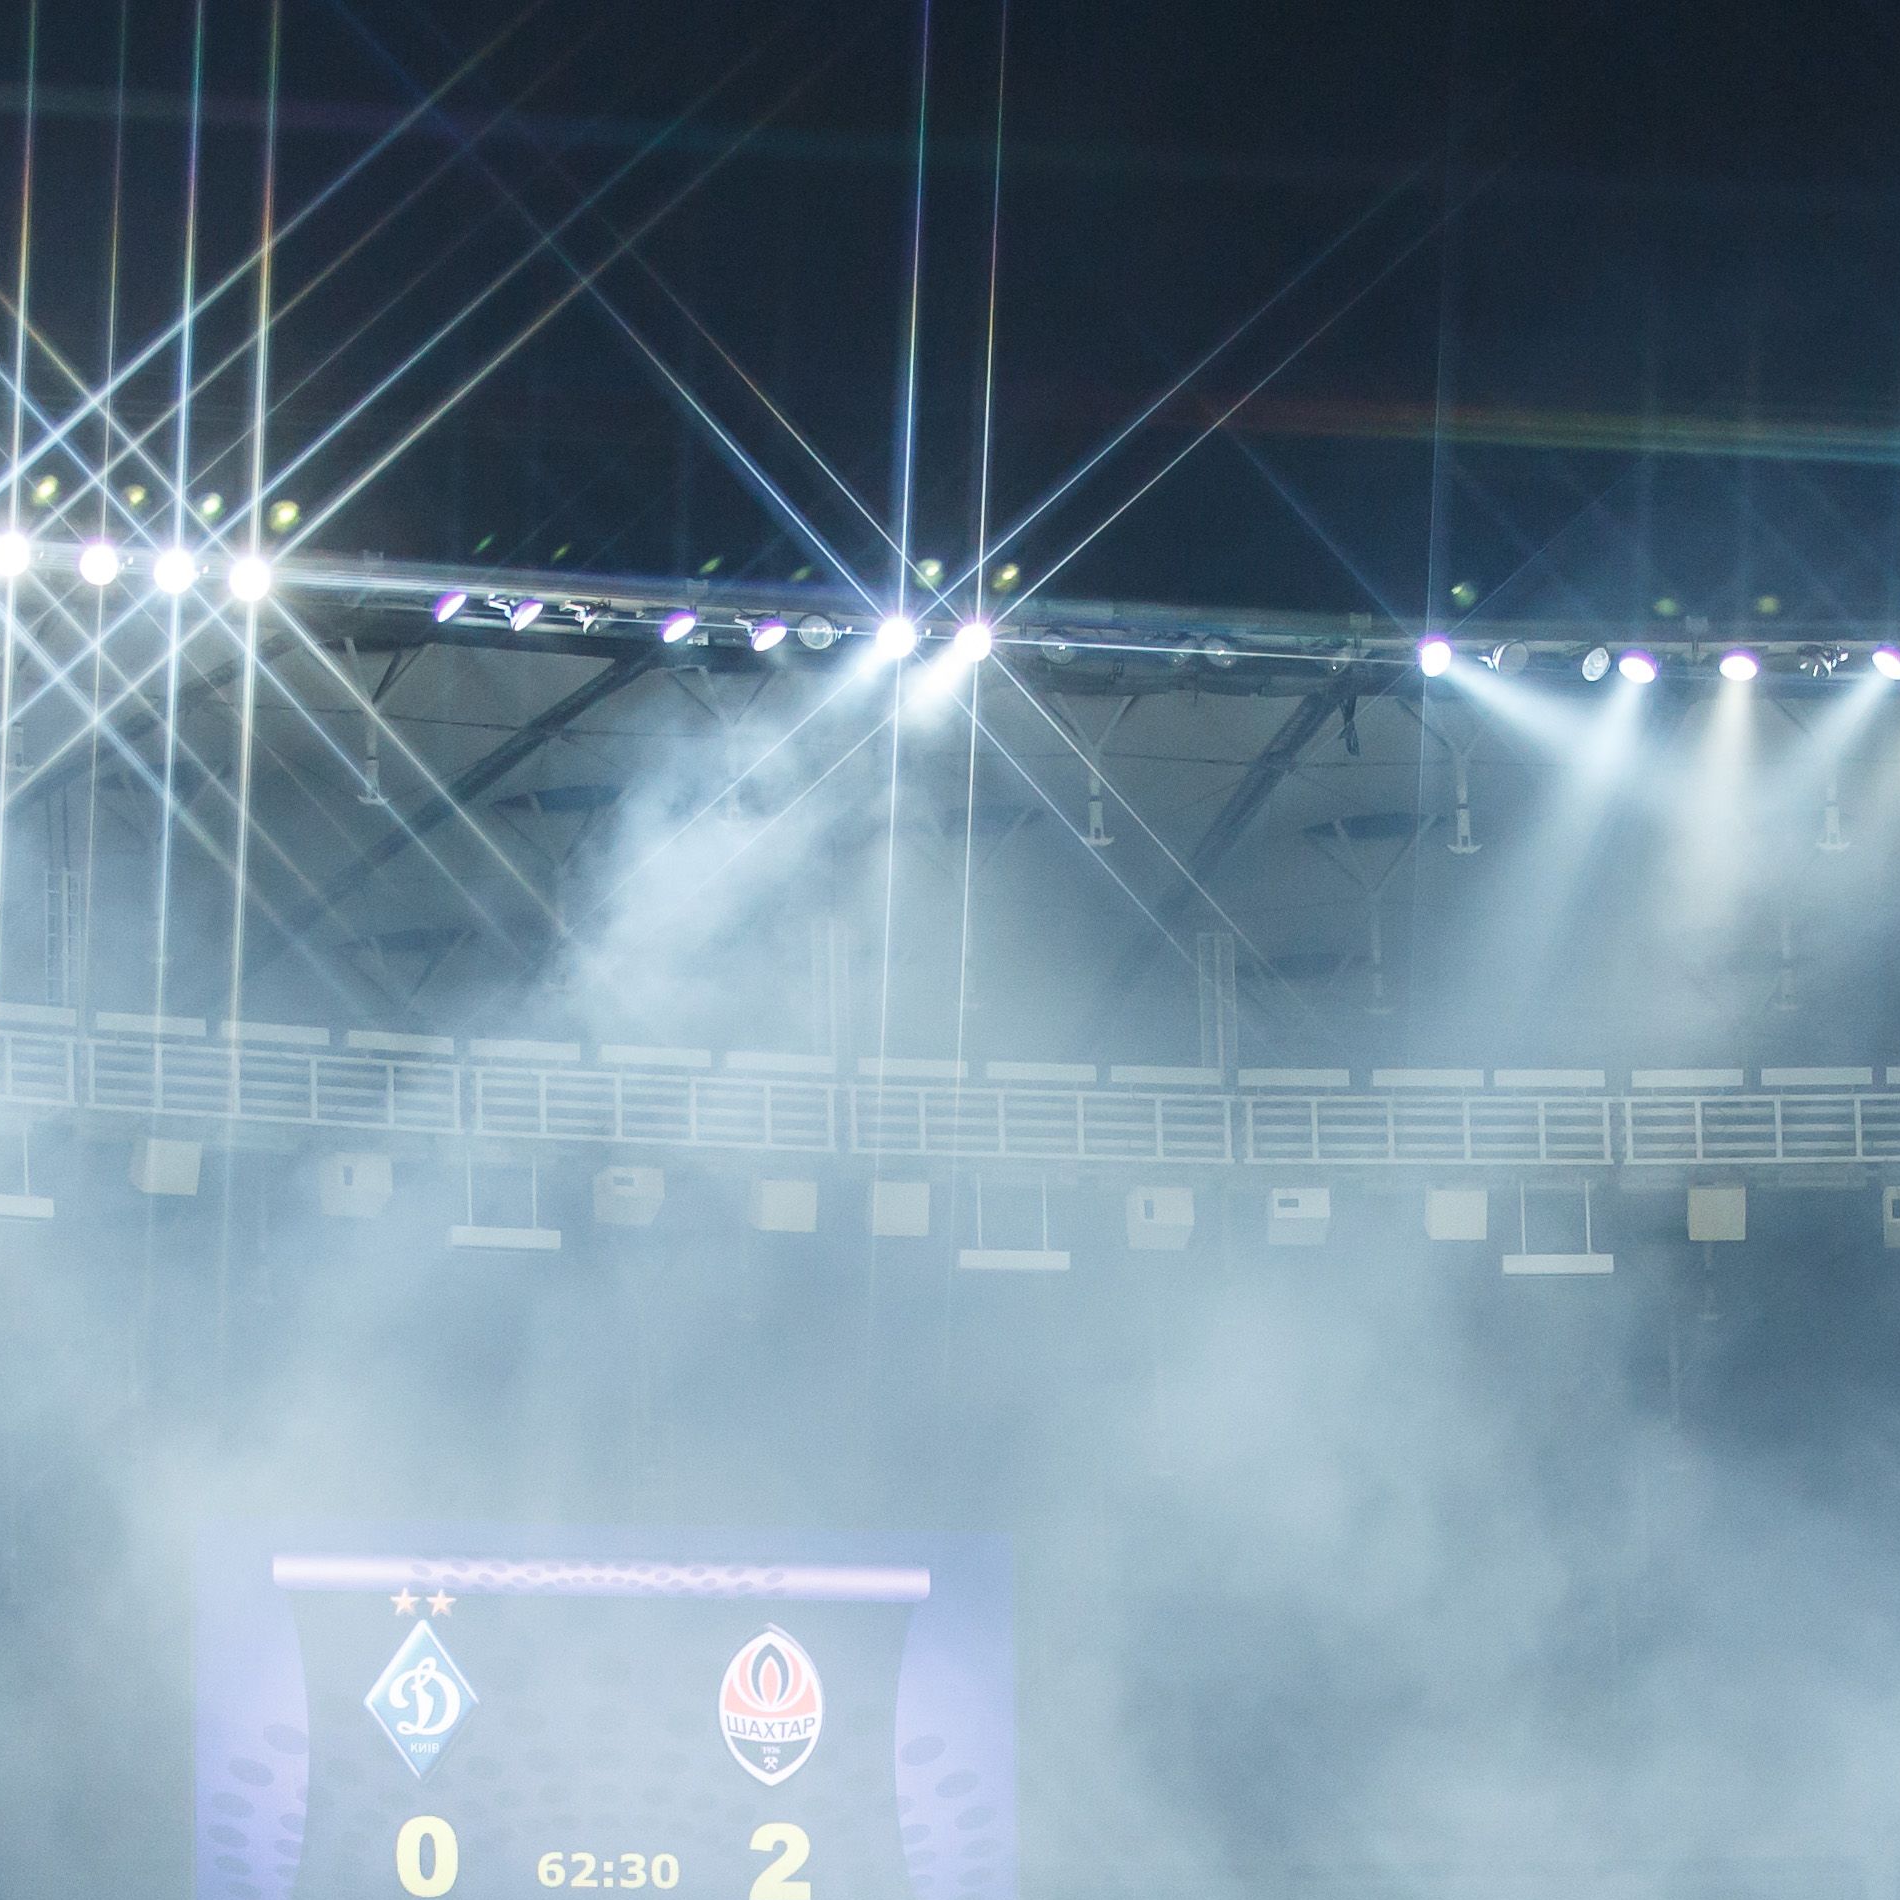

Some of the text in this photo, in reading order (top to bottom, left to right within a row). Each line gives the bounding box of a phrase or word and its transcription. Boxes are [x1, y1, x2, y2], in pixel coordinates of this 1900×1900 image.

[726, 1714, 816, 1739] ШАХТАР
[396, 1815, 459, 1898] 0
[537, 1851, 680, 1890] 62:30
